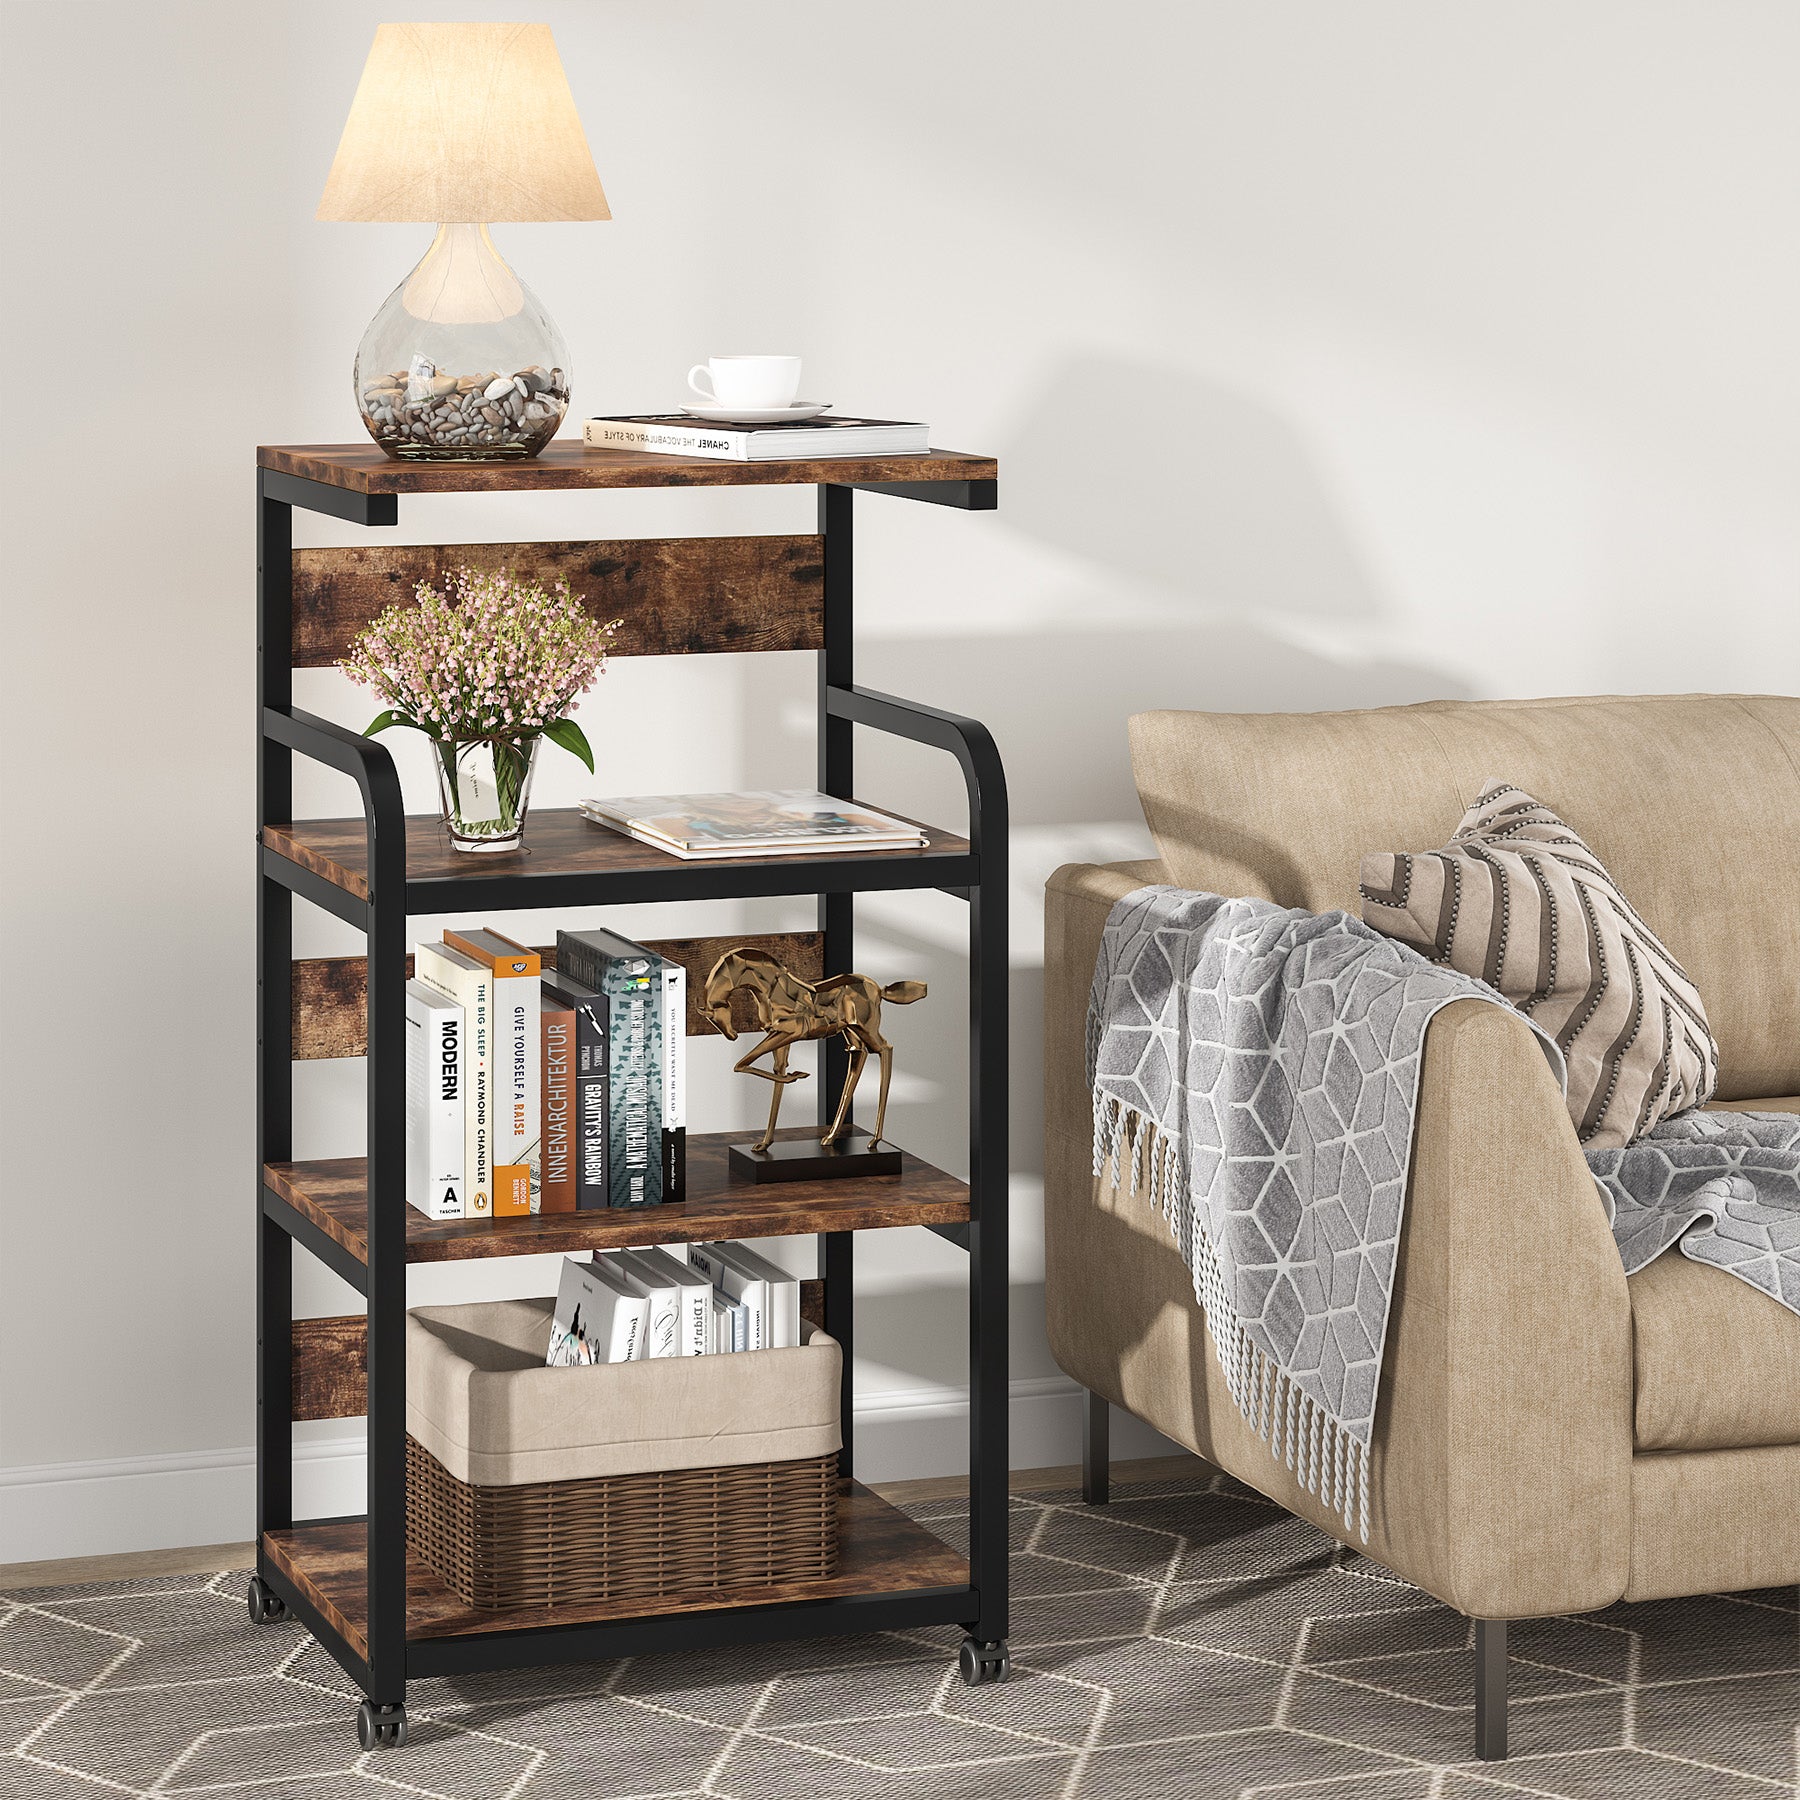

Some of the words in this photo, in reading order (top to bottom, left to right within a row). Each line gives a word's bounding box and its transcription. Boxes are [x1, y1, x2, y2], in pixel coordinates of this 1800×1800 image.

[478, 984, 486, 1003] THE
[478, 1007, 486, 1025] BIG
[514, 1006, 524, 1031] GIVE
[478, 1029, 486, 1057] SLEEP
[593, 1045, 603, 1067] THOMAS
[442, 1021, 458, 1101] MODERN
[514, 1036, 524, 1089] YOURSELF
[478, 1071, 486, 1125] RAYMOND
[626, 1075, 648, 1104] MOSAIC
[670, 1080, 676, 1090] ME
[547, 1023, 568, 1184] INNENARCHITEKTUR
[584, 1084, 602, 1136] GRAVITY'S
[514, 1104, 524, 1136] RAISE
[626, 1106, 648, 1162] MATHEMATICAL
[478, 1129, 486, 1184] CHANDLER
[584, 1139, 602, 1186] RAINBOW
[443, 1187, 458, 1203] A
[512, 1178, 520, 1206] BENNETT
